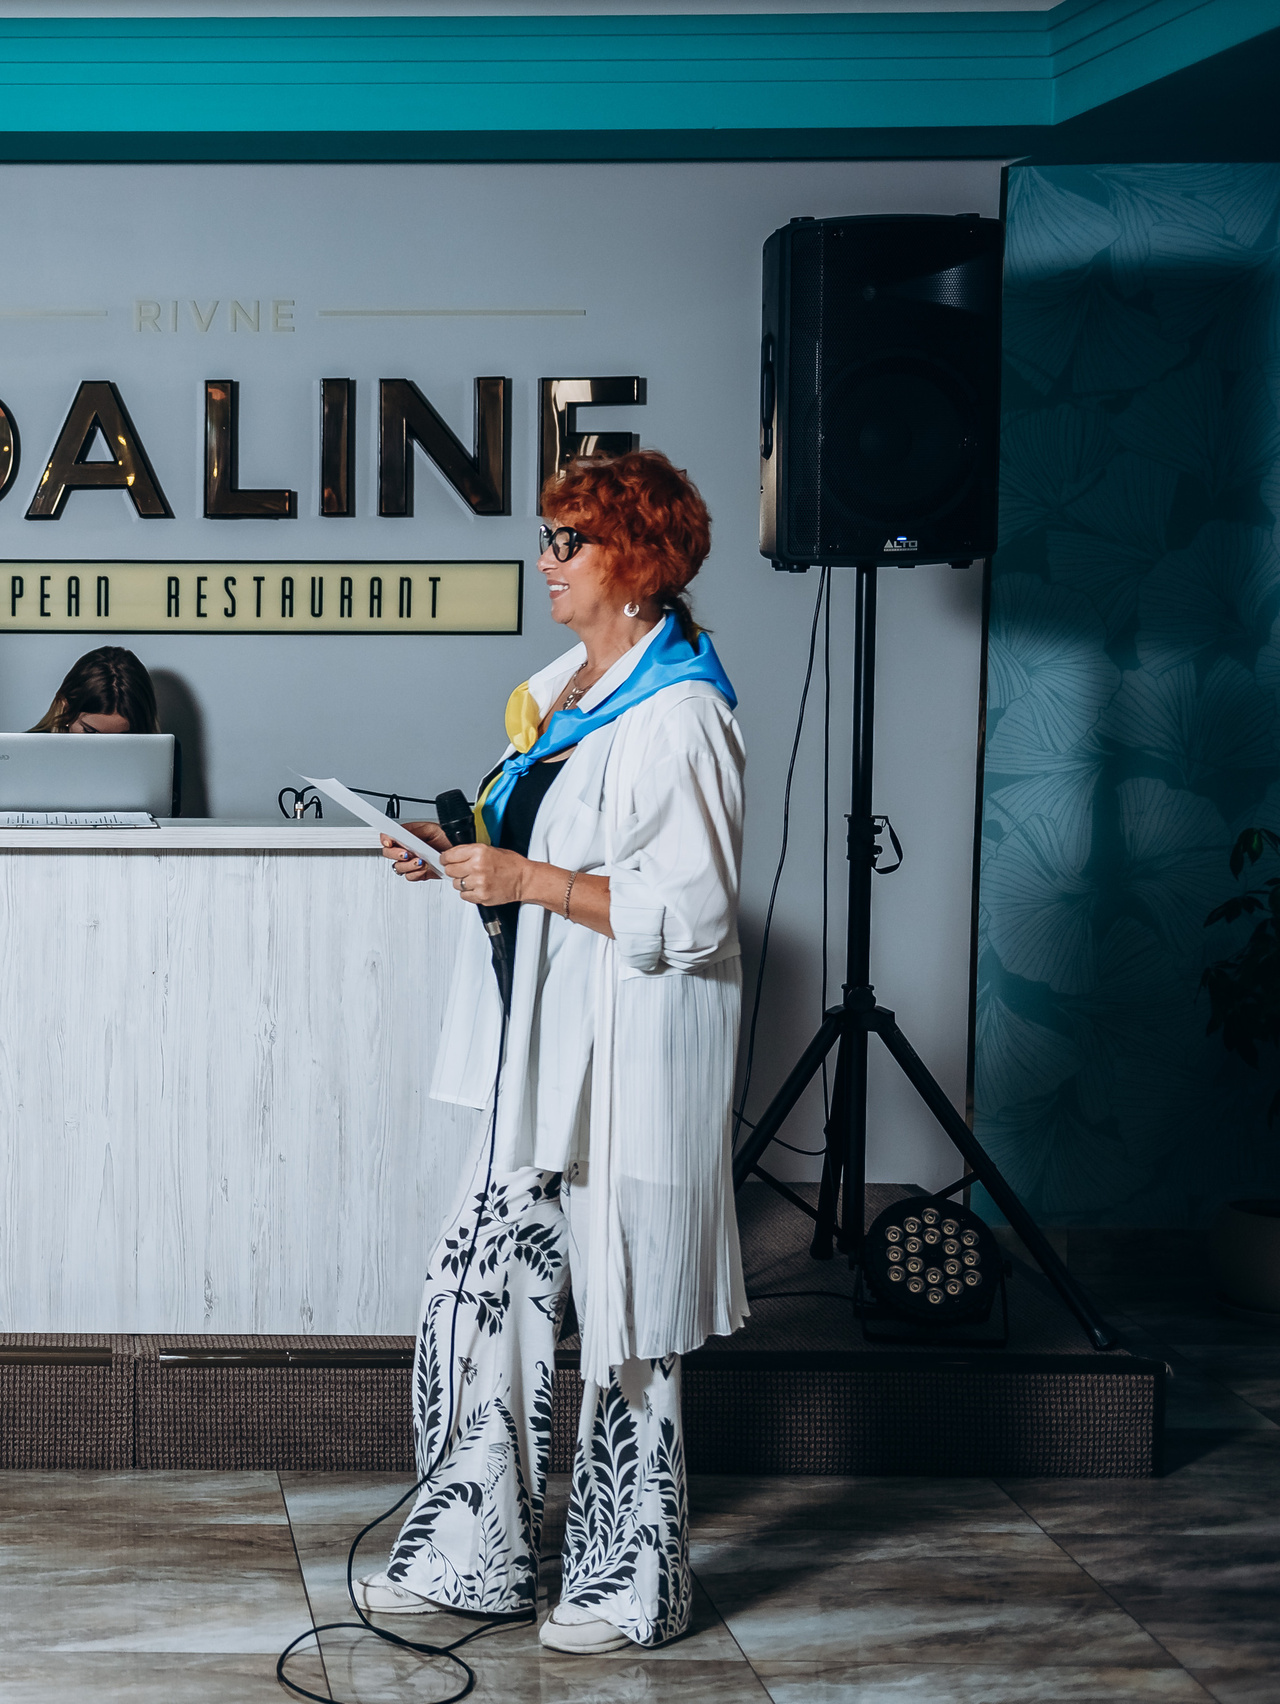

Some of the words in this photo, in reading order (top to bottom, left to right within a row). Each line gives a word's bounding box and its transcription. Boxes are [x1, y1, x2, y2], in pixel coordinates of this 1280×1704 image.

[135, 299, 296, 333] RIVNE
[884, 539, 917, 548] ALTO
[167, 576, 442, 618] RESTAURANT
